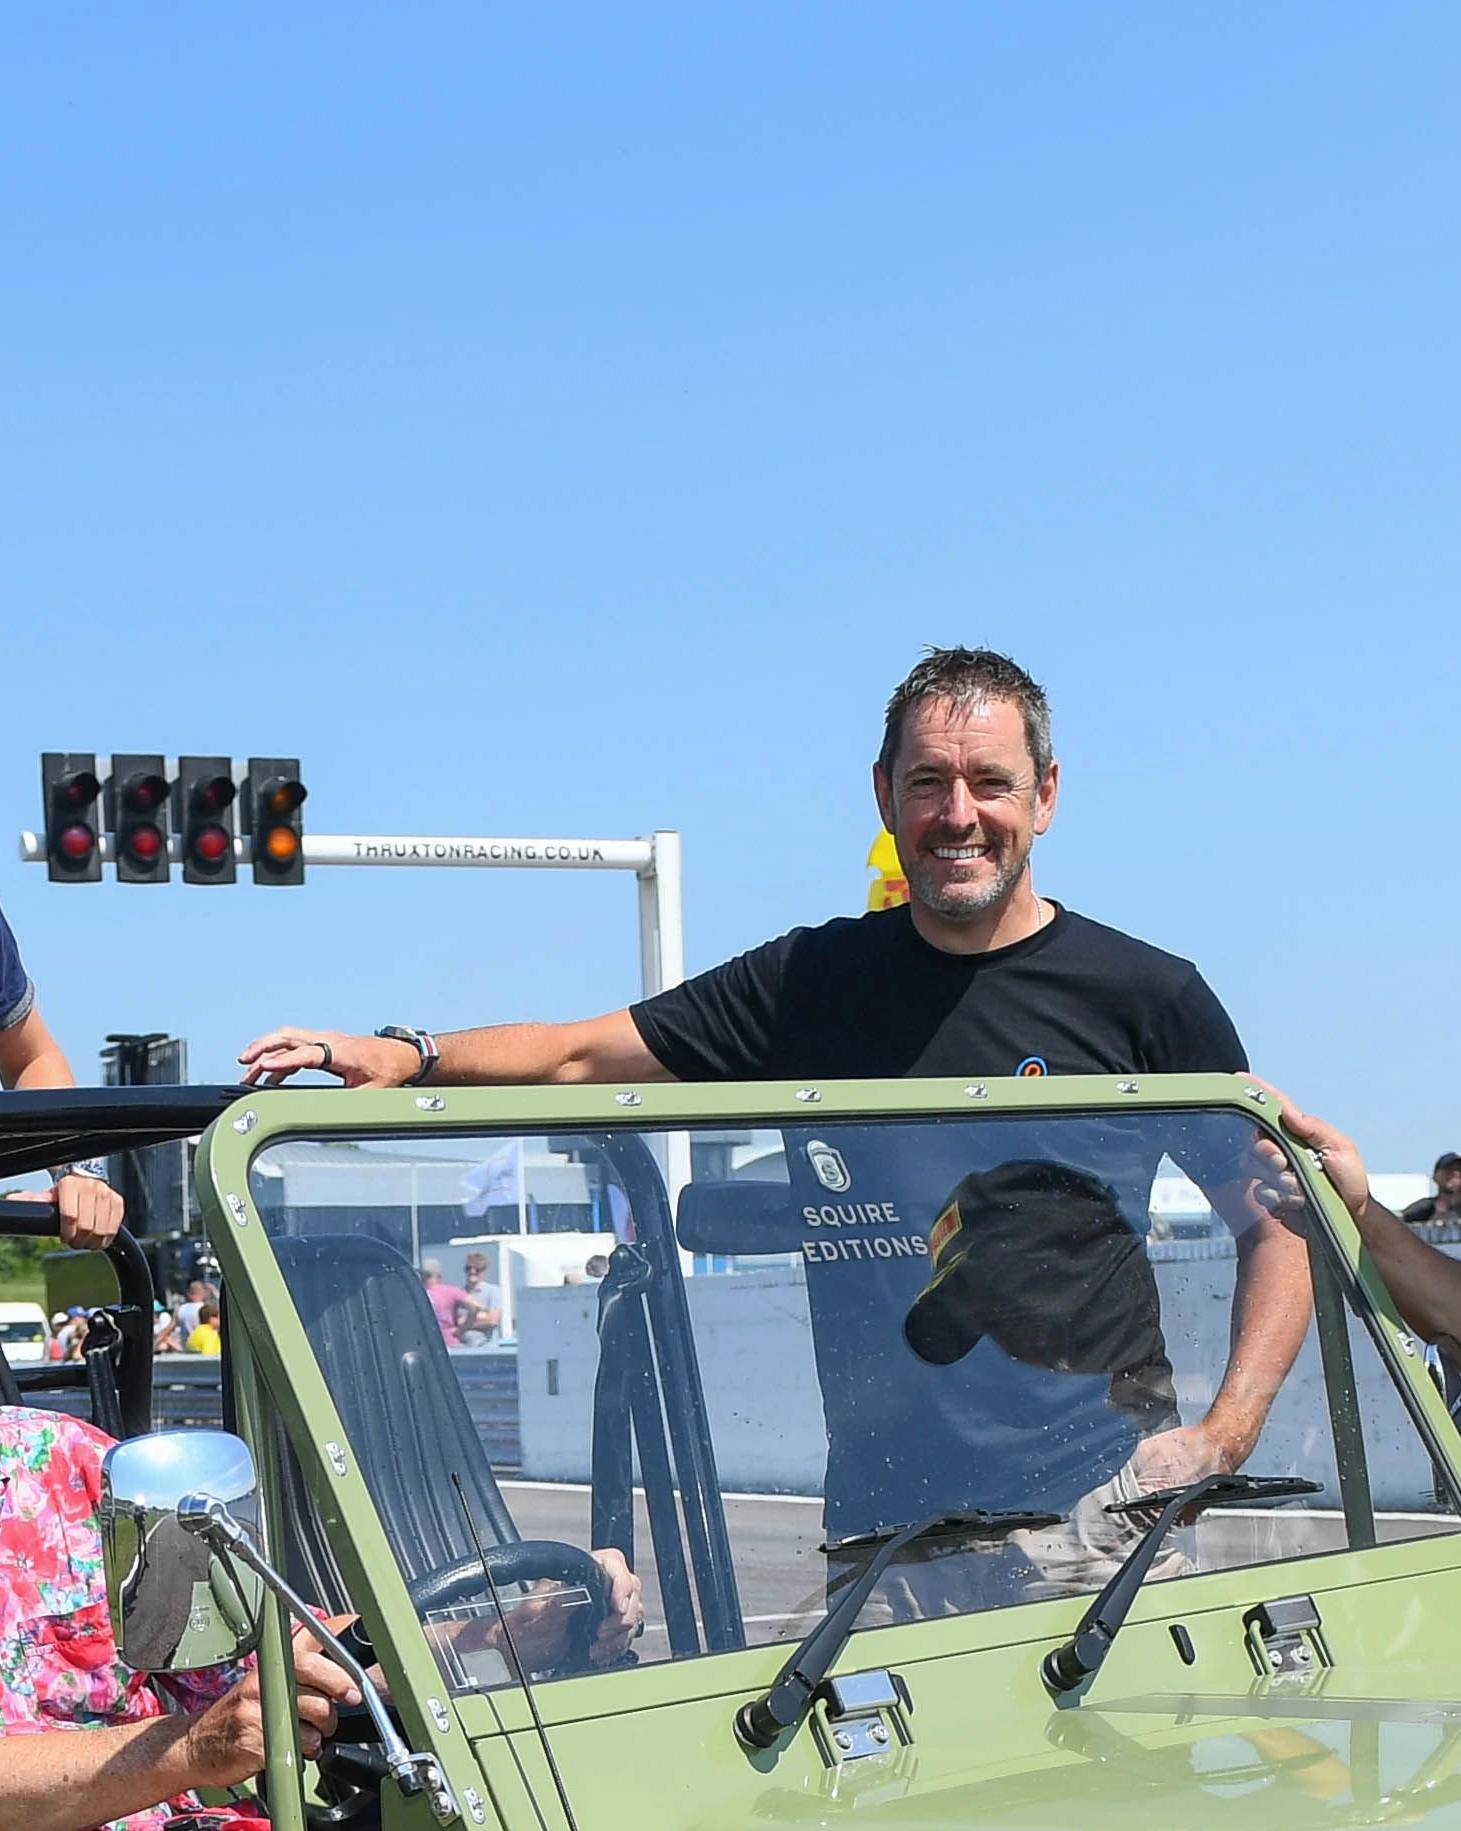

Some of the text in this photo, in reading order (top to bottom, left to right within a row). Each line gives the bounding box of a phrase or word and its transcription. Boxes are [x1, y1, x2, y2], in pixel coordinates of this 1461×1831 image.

[353, 842, 605, 862] THRUXTONRACING.CO.UK
[803, 1203, 899, 1227] SQUIRE
[802, 1236, 928, 1263] EDITIONS
